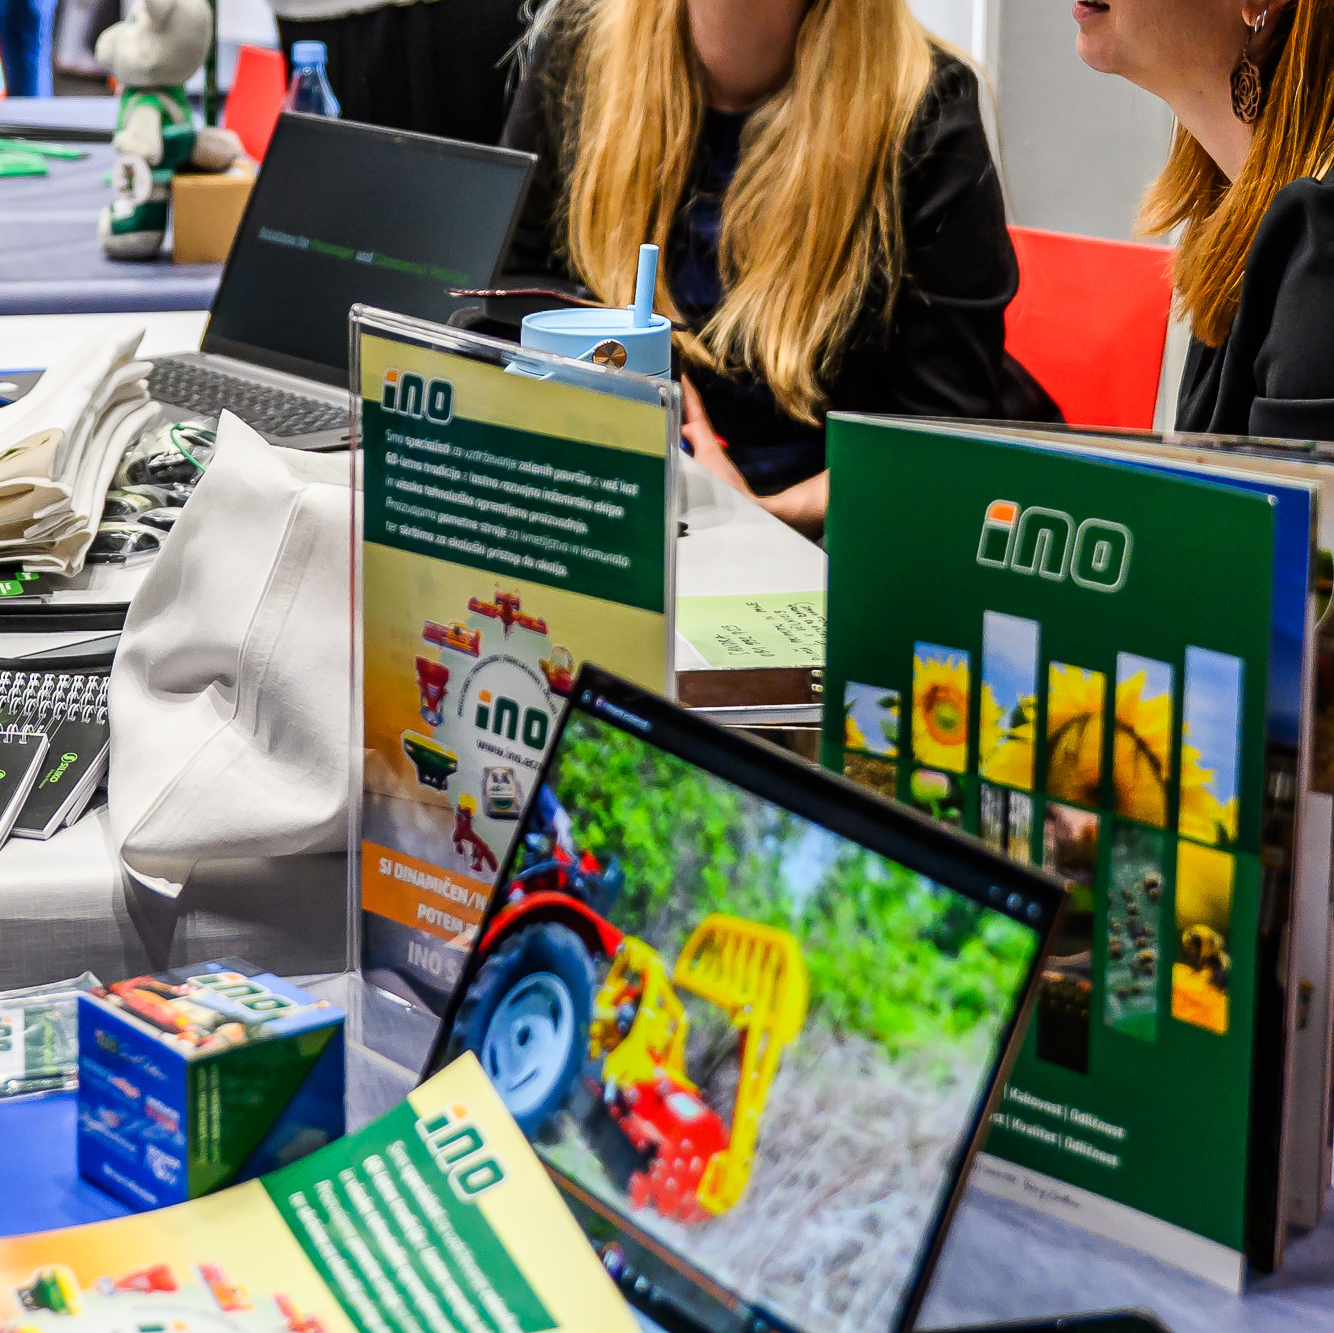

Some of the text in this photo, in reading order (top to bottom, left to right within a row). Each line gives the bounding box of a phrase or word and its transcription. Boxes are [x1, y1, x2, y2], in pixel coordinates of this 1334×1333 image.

[380, 368, 455, 426] ino
[975, 498, 1135, 594] ino
[475, 688, 549, 751] ino
[415, 1102, 509, 1204] ino
